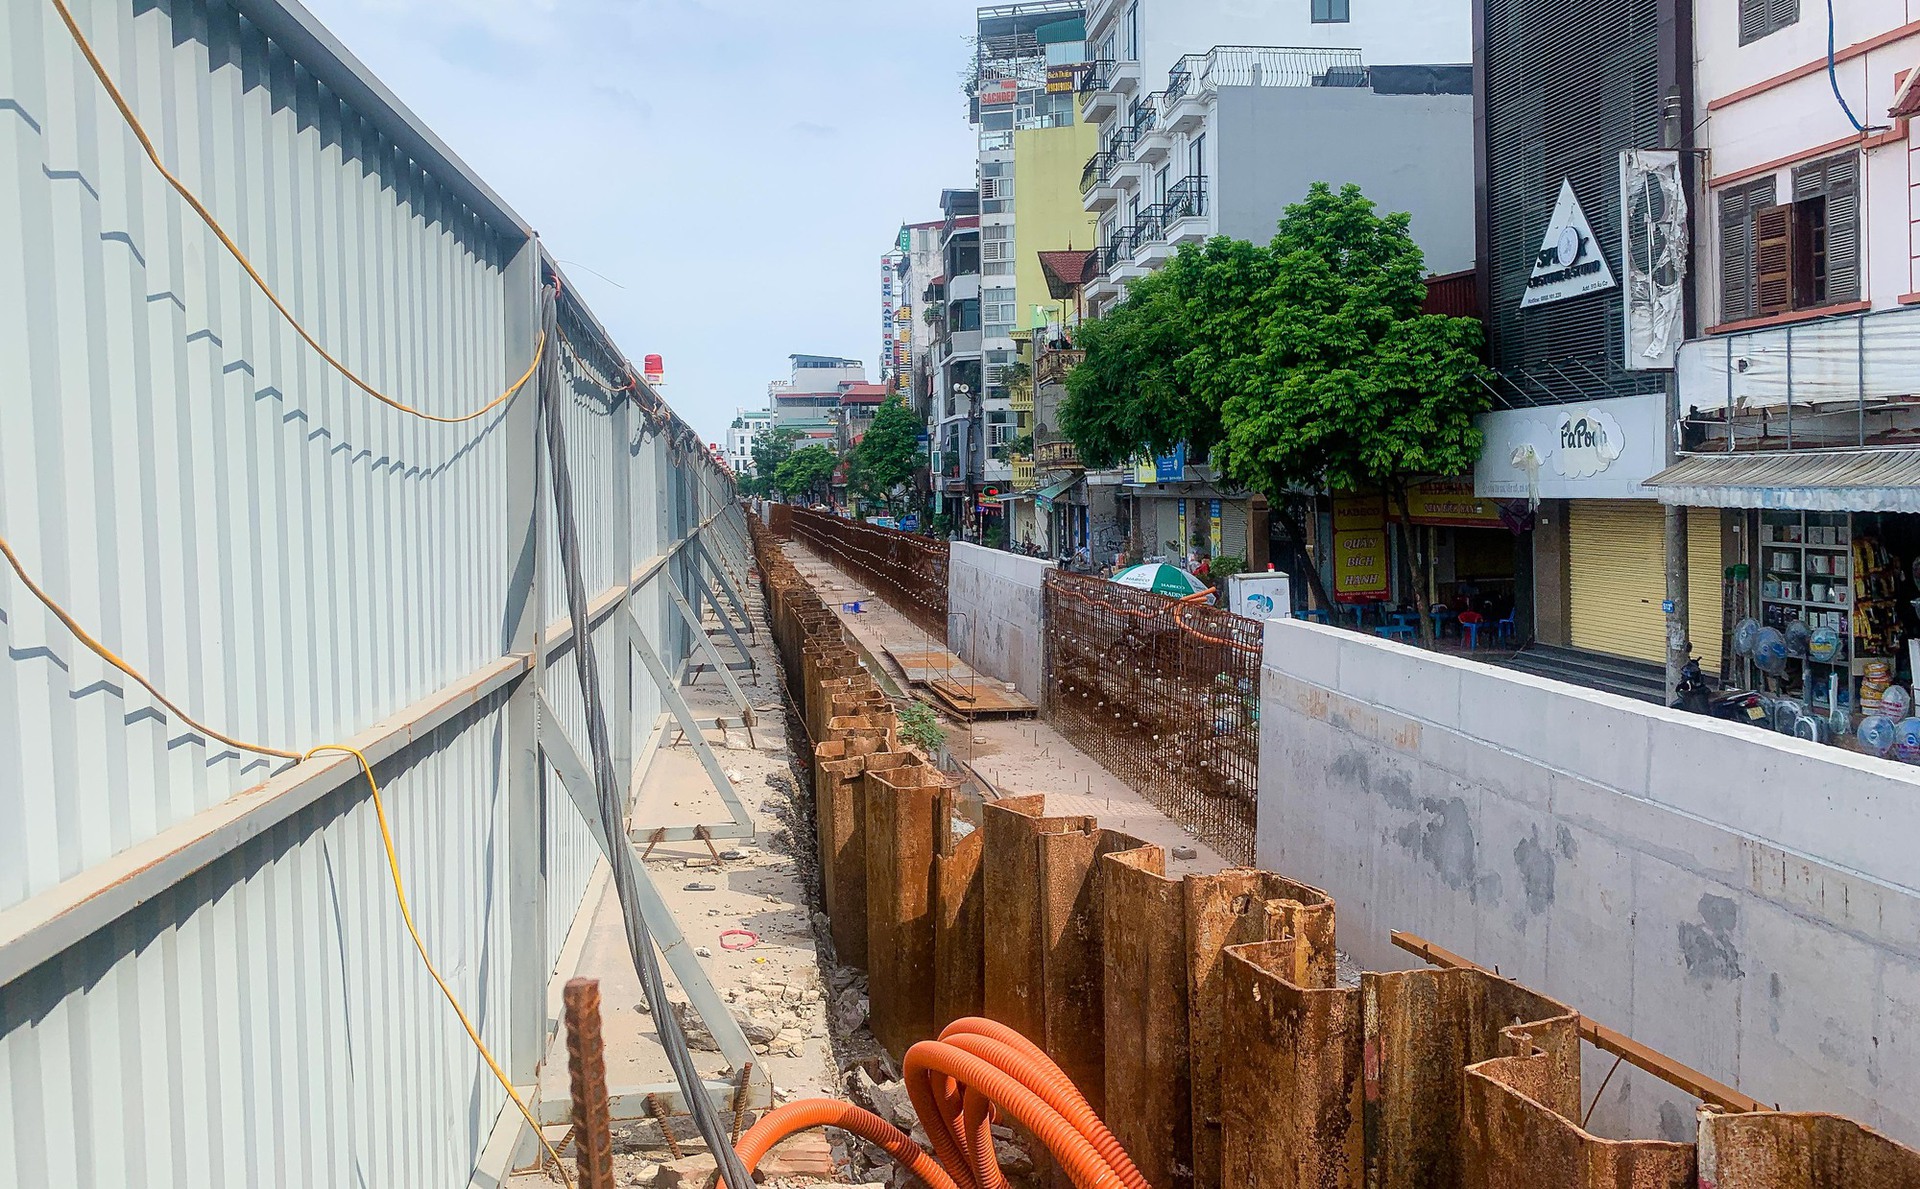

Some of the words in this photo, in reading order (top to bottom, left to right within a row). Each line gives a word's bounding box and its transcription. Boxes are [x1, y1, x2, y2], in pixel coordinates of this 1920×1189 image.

[883, 301, 892, 329] XANH
[884, 333, 893, 367] HOTEL
[1343, 534, 1378, 550] QUÁN
[1346, 552, 1375, 568] BÍCH
[1160, 582, 1186, 590] HABECO
[1344, 573, 1379, 588] HẠNH
